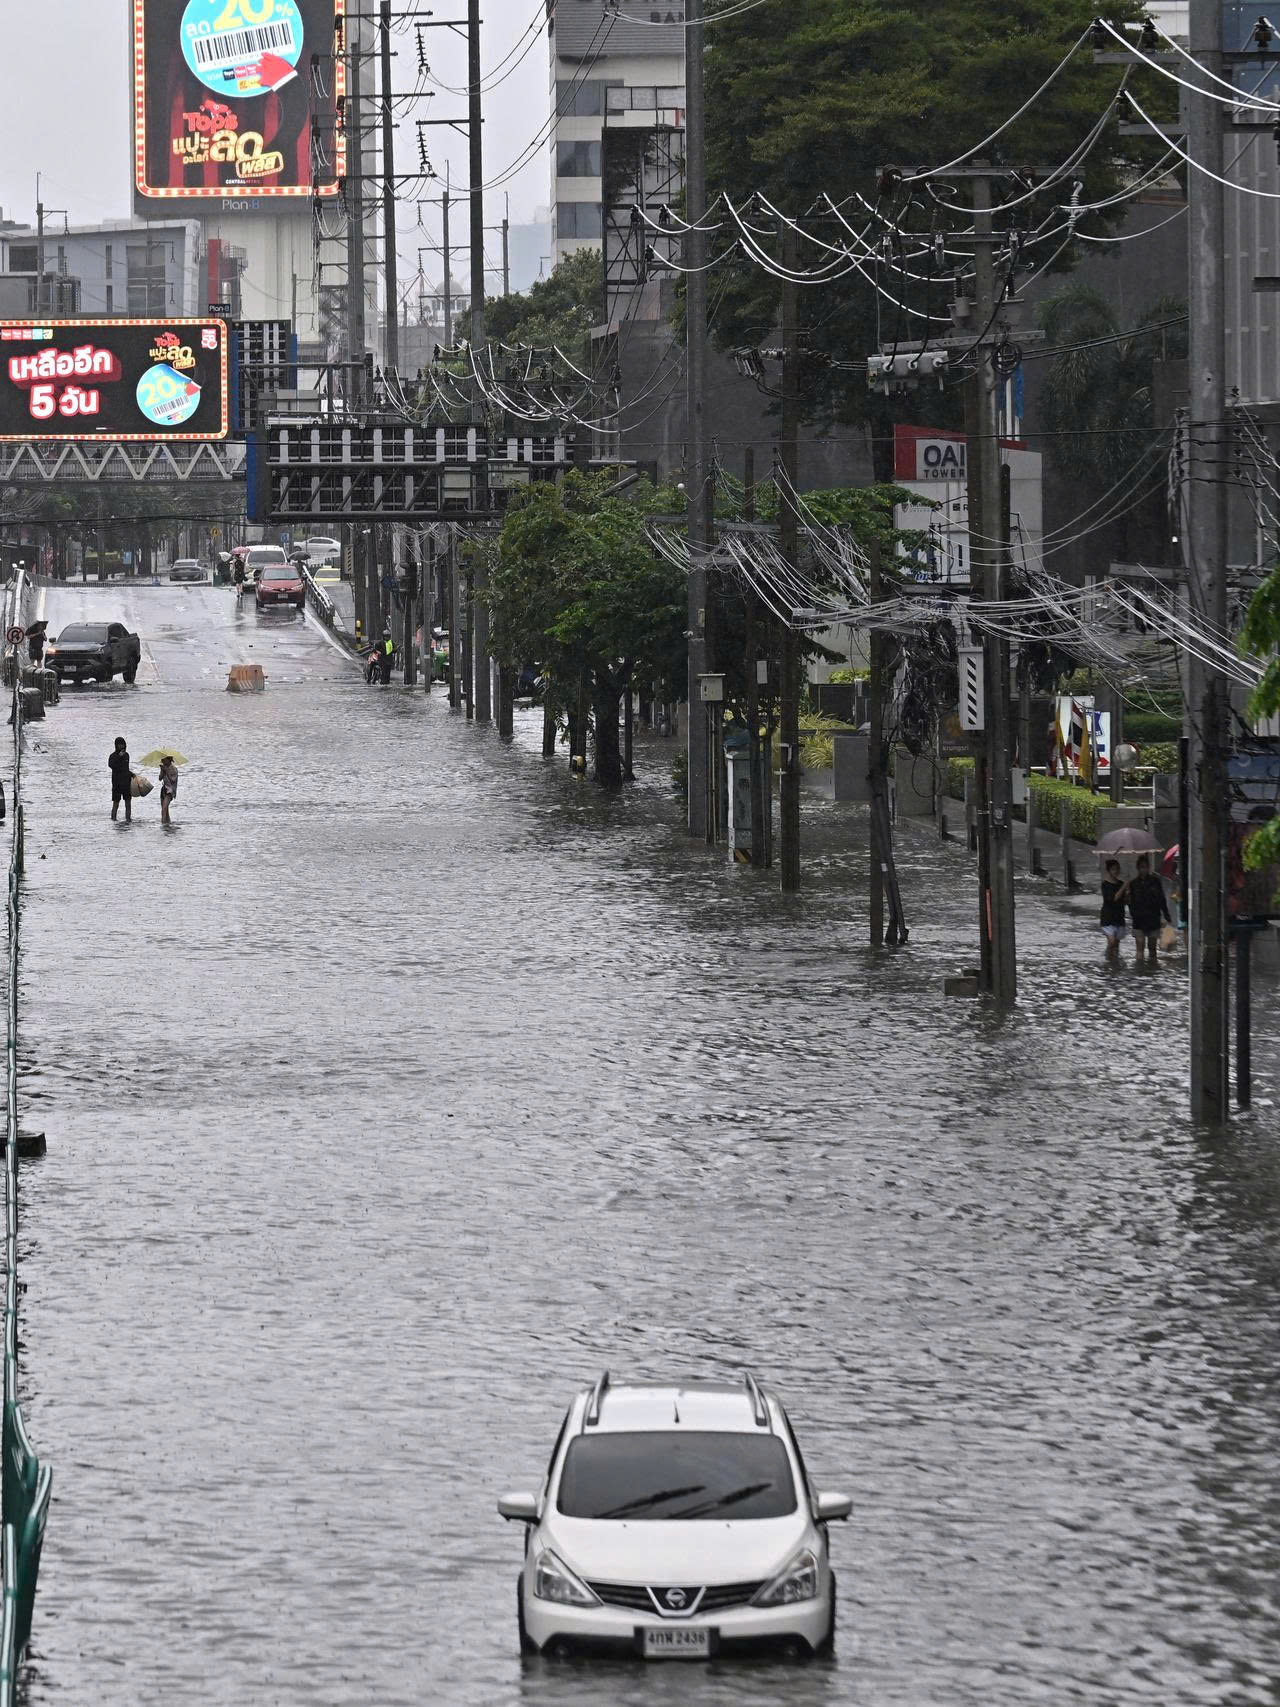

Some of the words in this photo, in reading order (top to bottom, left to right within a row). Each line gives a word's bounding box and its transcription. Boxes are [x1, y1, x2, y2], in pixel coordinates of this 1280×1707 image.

[183, 112, 238, 134] Tops
[10, 346, 111, 379] เหลืออีก
[31, 385, 55, 418] 5
[61, 387, 97, 414] วัน
[924, 469, 965, 478] TOWER
